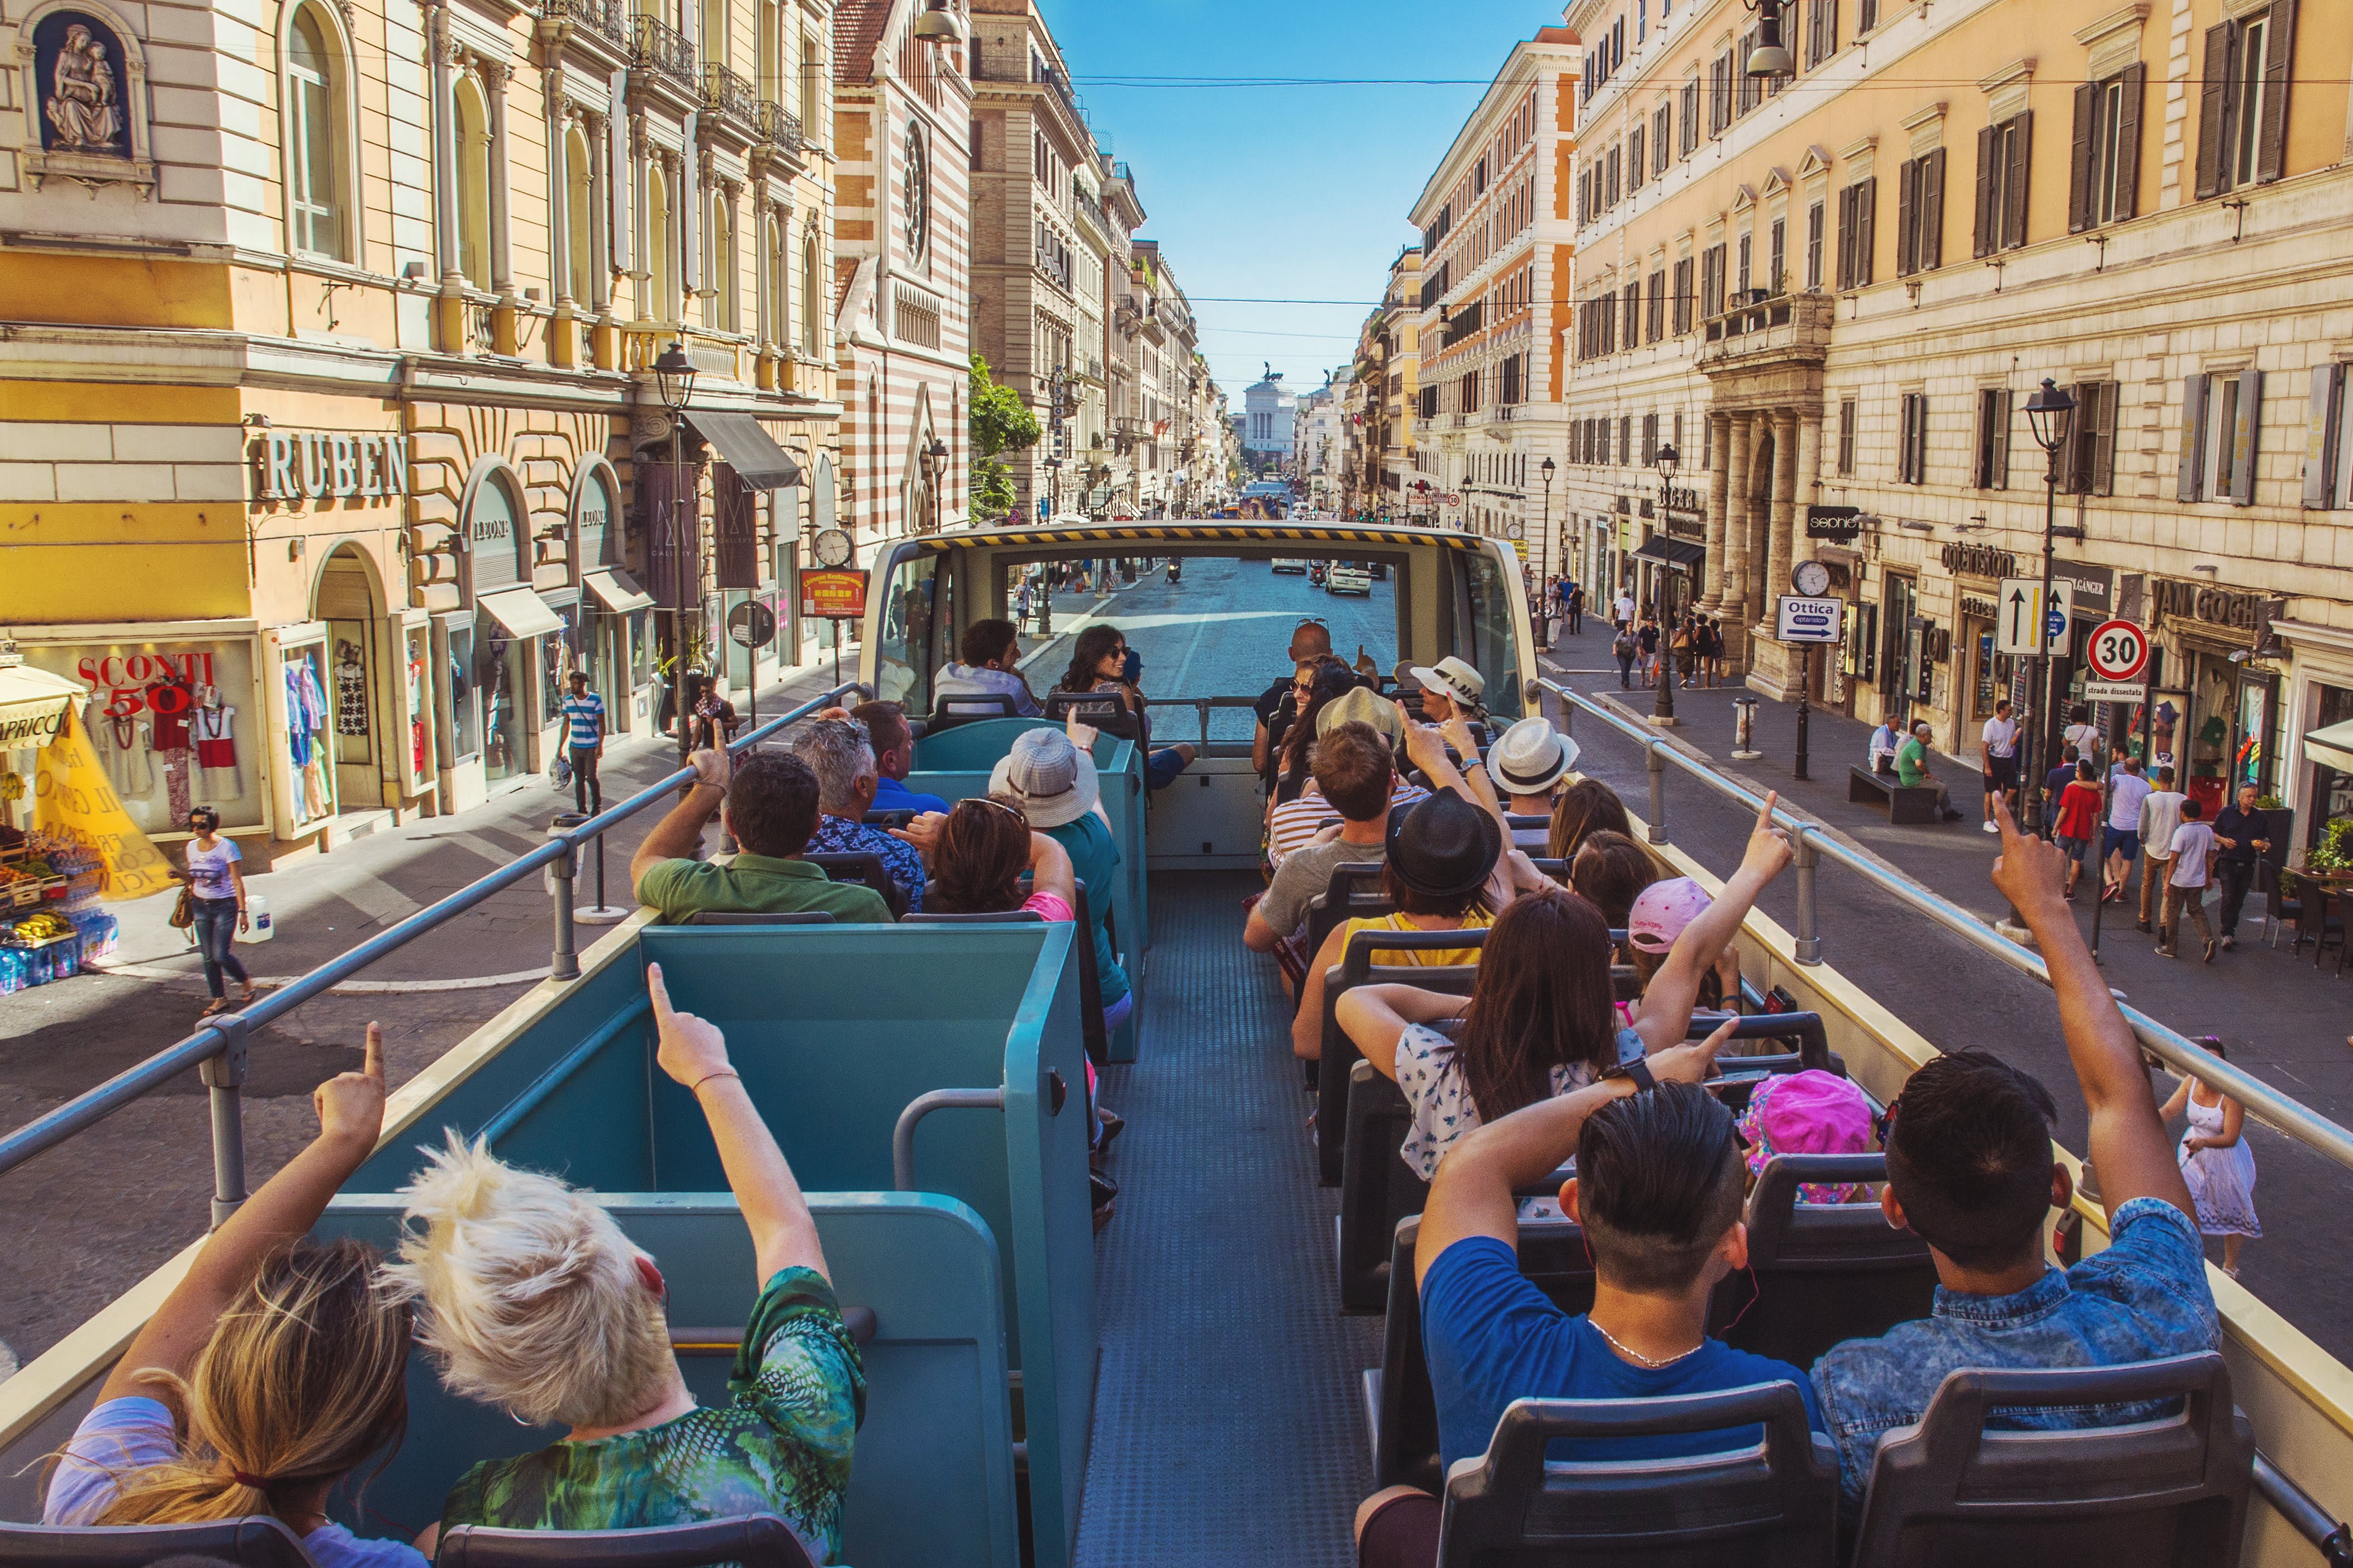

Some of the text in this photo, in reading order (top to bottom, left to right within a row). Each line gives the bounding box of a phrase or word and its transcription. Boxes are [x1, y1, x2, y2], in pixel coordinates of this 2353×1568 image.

[267, 432, 408, 498] RUBEN
[475, 520, 508, 540] LEONE
[581, 509, 606, 527] LEONE
[803, 573, 863, 588] Chinese Restaurante
[1789, 602, 1833, 614] Ottica
[2151, 579, 2194, 618] VAN
[2197, 588, 2259, 630] GOGH
[1795, 615, 1826, 623] optariston
[2102, 636, 2136, 664] 30
[78, 652, 213, 693] SCONTI
[103, 685, 190, 717] 50
[2110, 687, 2142, 696] dissestata
